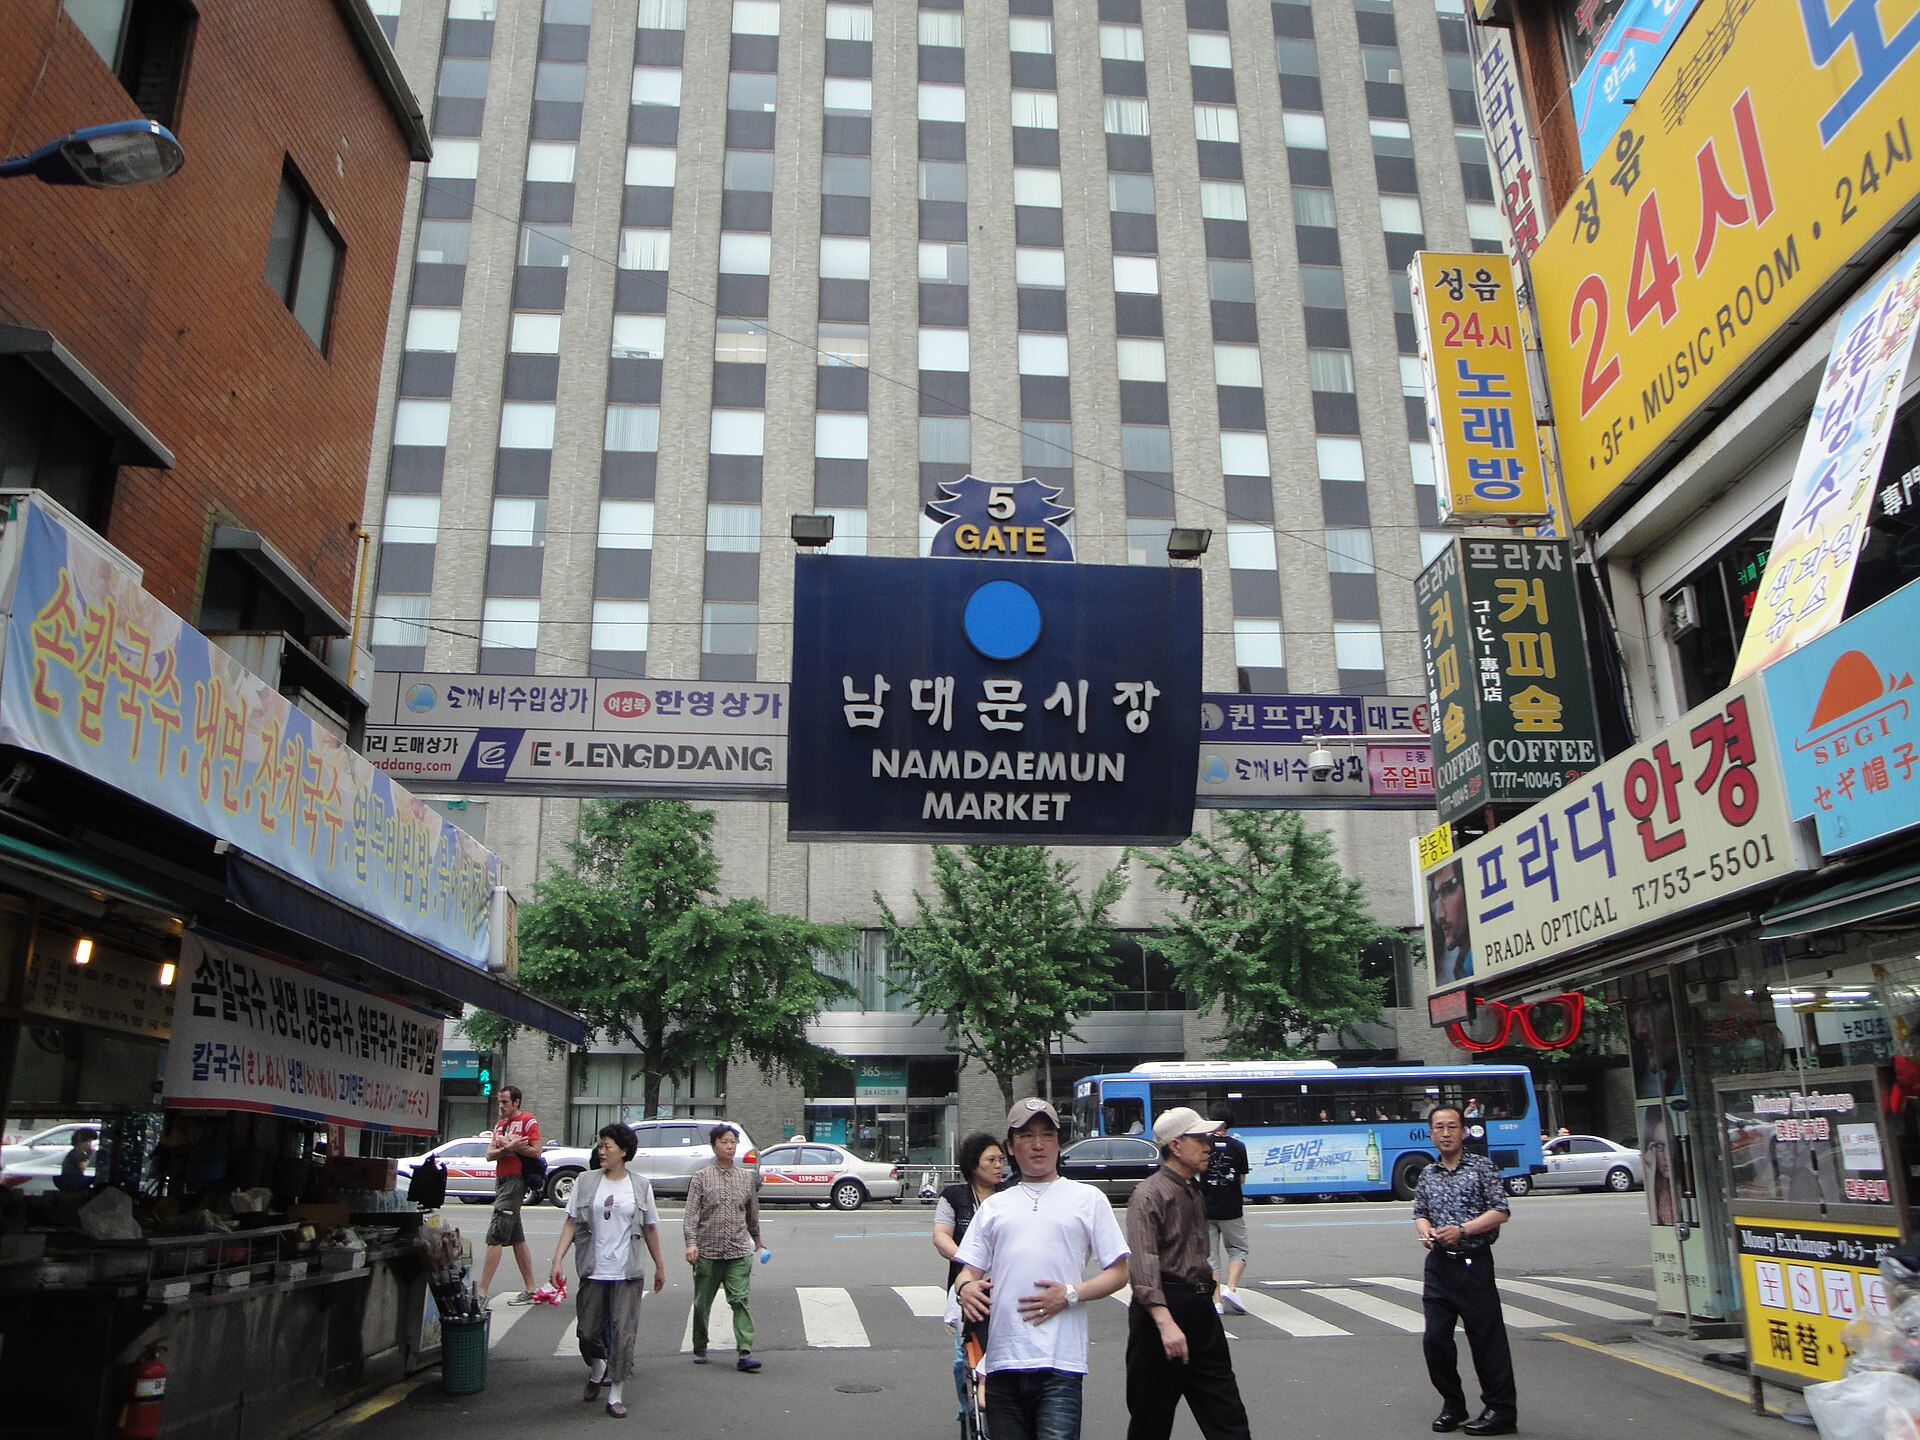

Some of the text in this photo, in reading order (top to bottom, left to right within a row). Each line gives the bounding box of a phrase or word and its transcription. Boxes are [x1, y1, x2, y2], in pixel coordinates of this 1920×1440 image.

[1603, 47, 1637, 104] 한국
[1572, 128, 1645, 245] 성음
[1569, 86, 1776, 421] 24시
[1641, 329, 1715, 425] MUSIC
[1718, 234, 1801, 350] ROOM
[1835, 116, 1913, 226] 24시
[1433, 267, 1502, 303] 성음
[1441, 310, 1514, 351] 24시
[1455, 358, 1526, 503] 노래방
[1791, 289, 1899, 535] 팥빙수
[987, 486, 1016, 520] 5
[954, 523, 1047, 554] GATE
[1469, 543, 1563, 572] 프라자
[1419, 548, 1456, 605] 프라자
[1764, 512, 1862, 609] 생과일
[608, 689, 783, 719] 여성복 한영상가
[841, 673, 1161, 735] 남대문시장
[1228, 703, 1356, 733] 퀸프라자
[392, 735, 459, 755] 도매상가
[1487, 739, 1597, 764] COFFEE
[1813, 716, 1892, 766] SEGI
[871, 748, 1126, 783] NAMDAEMUN
[1437, 741, 1482, 789] COFFEE
[1813, 742, 1920, 811] セギ帽子
[921, 790, 1071, 821] MARKET
[1419, 826, 1450, 866] 부동산
[1485, 833, 1775, 966] PRADA OPTICAL T.753-5501
[483, 1083, 492, 1096] 2
[860, 1066, 880, 1078] 365
[1752, 1091, 1855, 1114] Money Exchange
[1264, 1139, 1323, 1167] 흔들어라
[1741, 1230, 1776, 1253] Money
